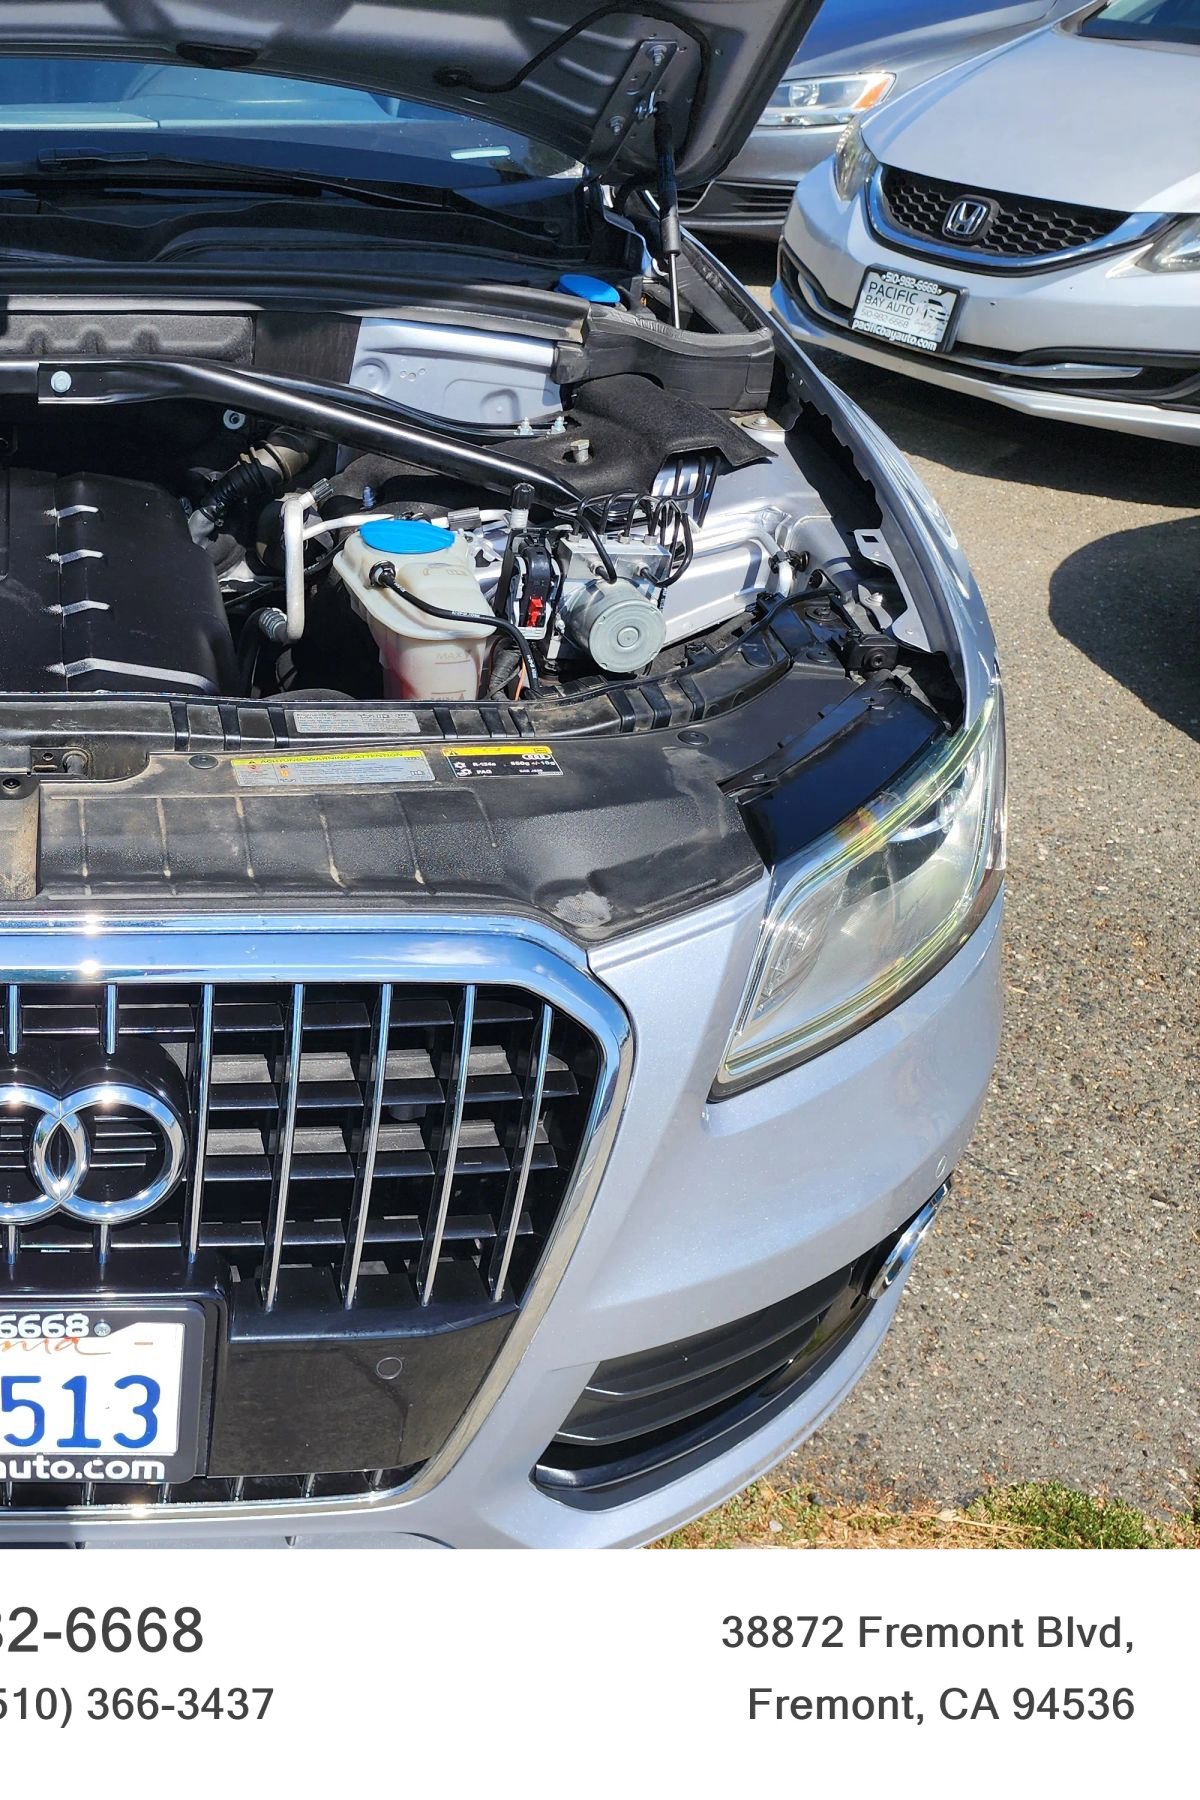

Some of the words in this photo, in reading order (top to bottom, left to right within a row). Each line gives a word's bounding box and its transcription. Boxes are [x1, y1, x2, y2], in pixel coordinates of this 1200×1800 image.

[864, 294, 886, 307] BAY
[887, 301, 914, 316] AUTO
[868, 281, 919, 305] PACIFIC
[851, 318, 938, 352] pacificbayauto.com
